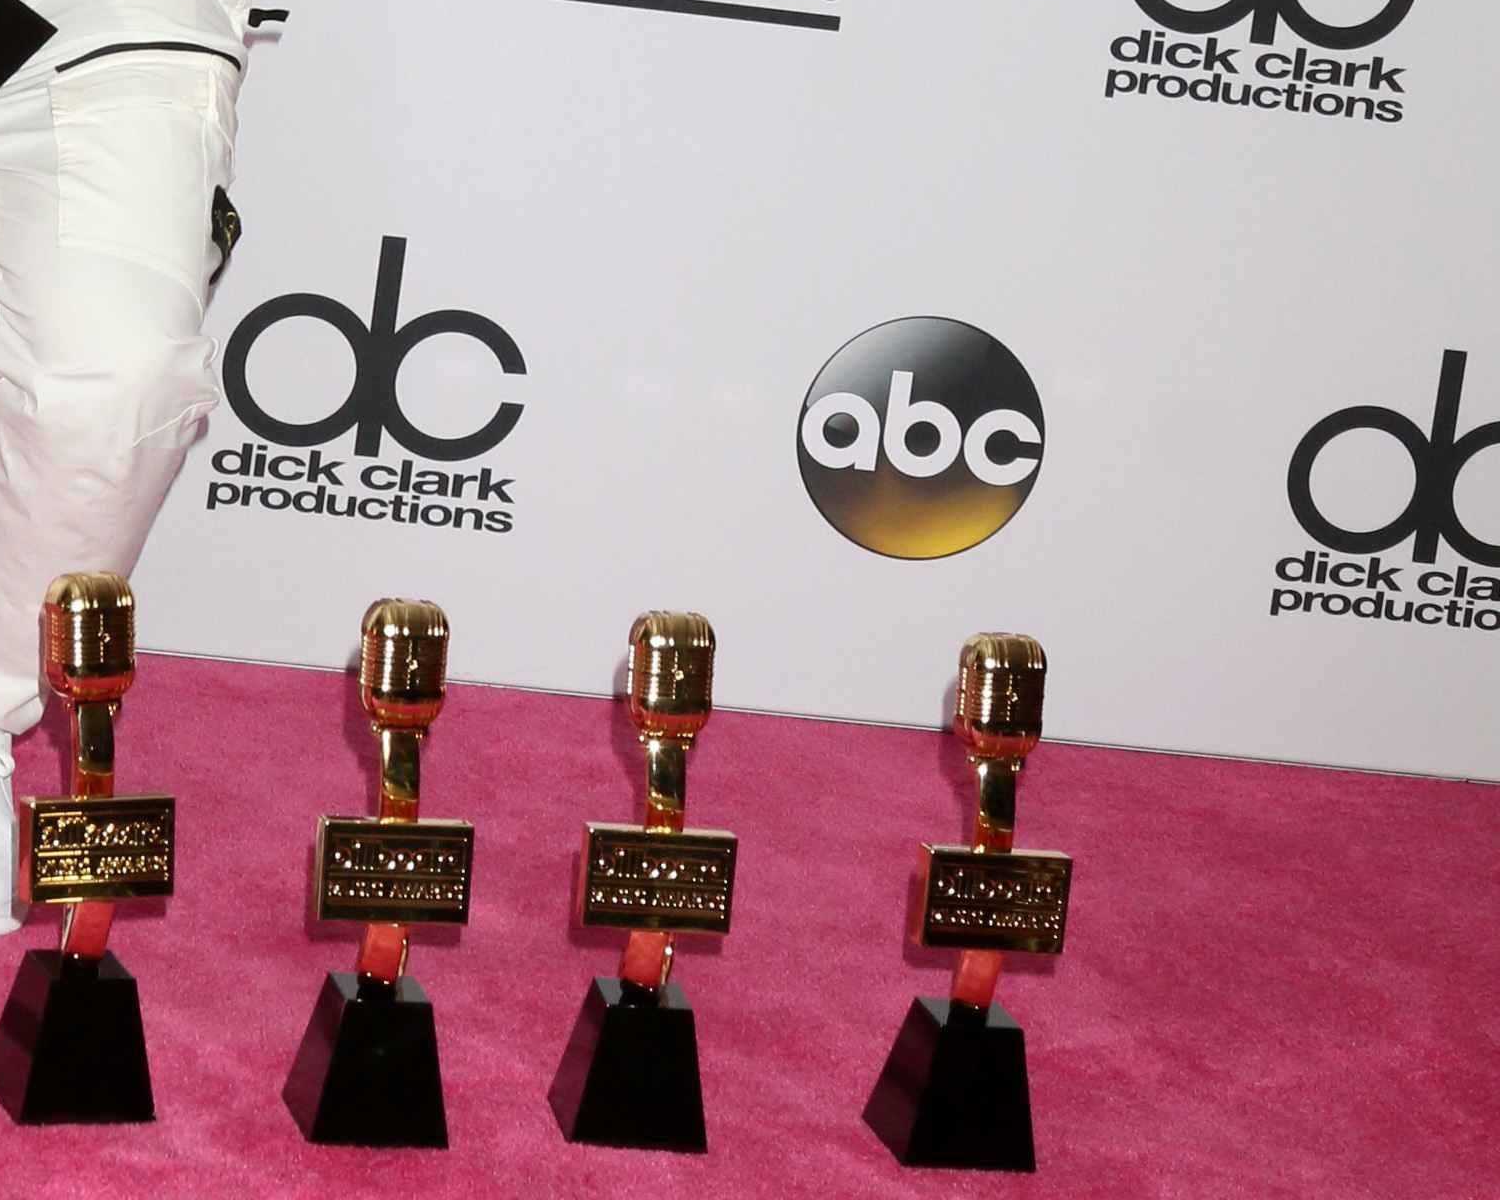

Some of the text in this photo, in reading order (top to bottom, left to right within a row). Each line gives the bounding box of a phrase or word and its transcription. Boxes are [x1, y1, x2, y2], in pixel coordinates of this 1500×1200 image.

[1110, 30, 1406, 93] dick clark
[1105, 69, 1403, 122] productions
[802, 370, 1042, 486] abc
[211, 443, 514, 503] dick clark
[207, 482, 512, 532] productions
[1275, 551, 1500, 603] dick cla
[1270, 589, 1500, 631] productio
